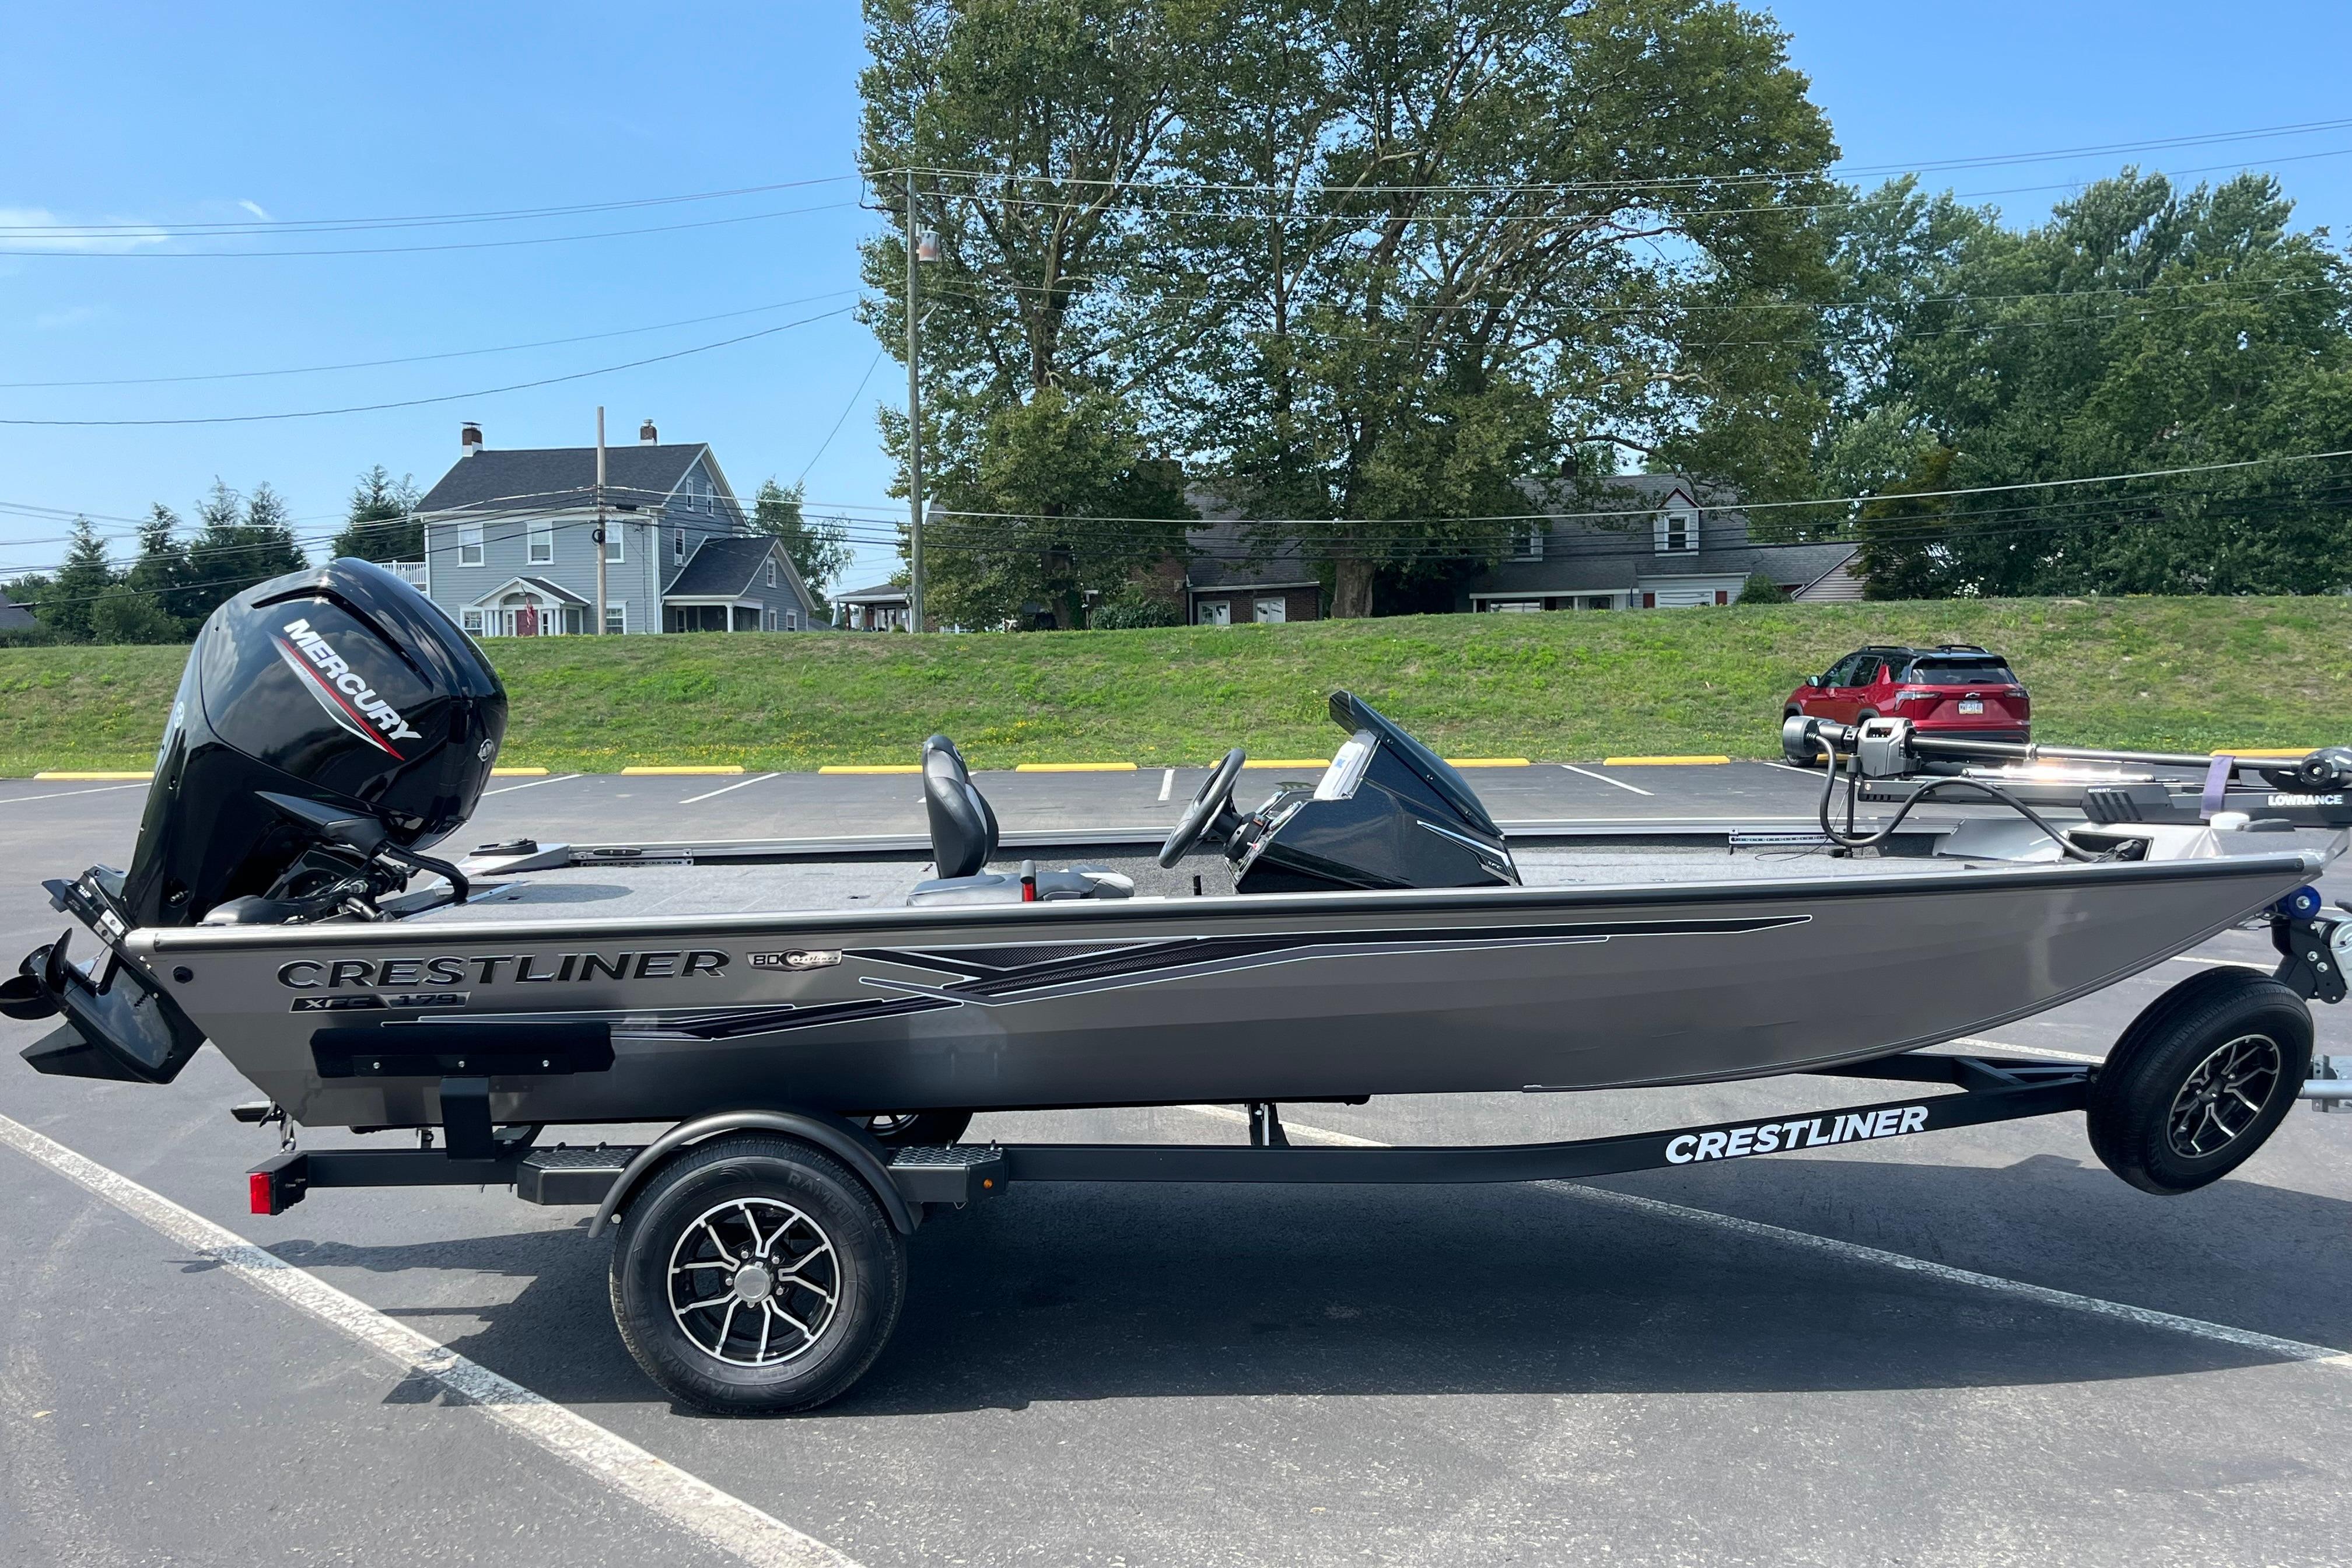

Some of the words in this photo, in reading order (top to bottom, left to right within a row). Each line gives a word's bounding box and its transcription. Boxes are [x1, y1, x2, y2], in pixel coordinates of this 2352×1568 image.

[283, 618, 422, 740] MERCURY
[2268, 794, 2343, 806] LOWRANCE
[276, 949, 731, 989] CRESTLINER
[304, 997, 370, 1009] XFC
[398, 993, 458, 1006] 179
[1666, 1106, 1928, 1163] CRESTLINER
